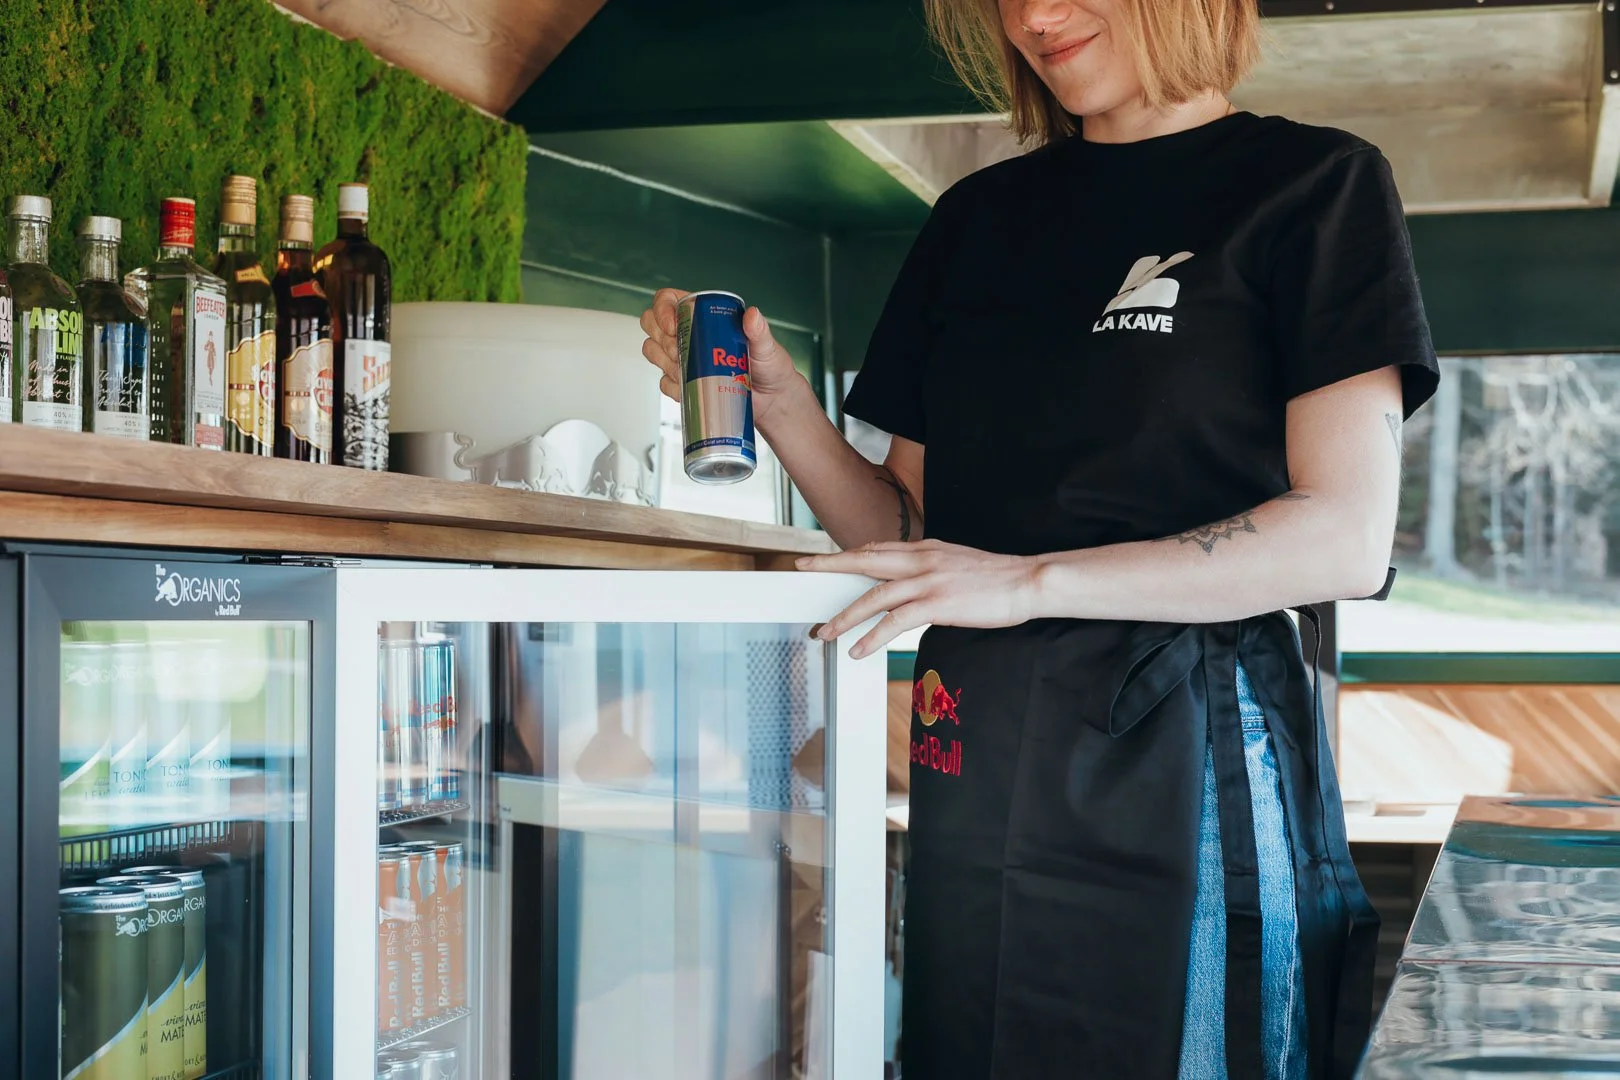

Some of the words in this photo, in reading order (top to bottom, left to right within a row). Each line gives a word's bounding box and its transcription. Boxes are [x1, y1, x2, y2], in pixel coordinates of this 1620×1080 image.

[195, 296, 226, 317] BEEFEATER
[1092, 316, 1115, 333] LA
[1118, 313, 1173, 333] KAVE
[712, 347, 747, 371] Red
[155, 564, 166, 576] The
[167, 572, 241, 607] ORGANICS
[115, 914, 126, 922] The
